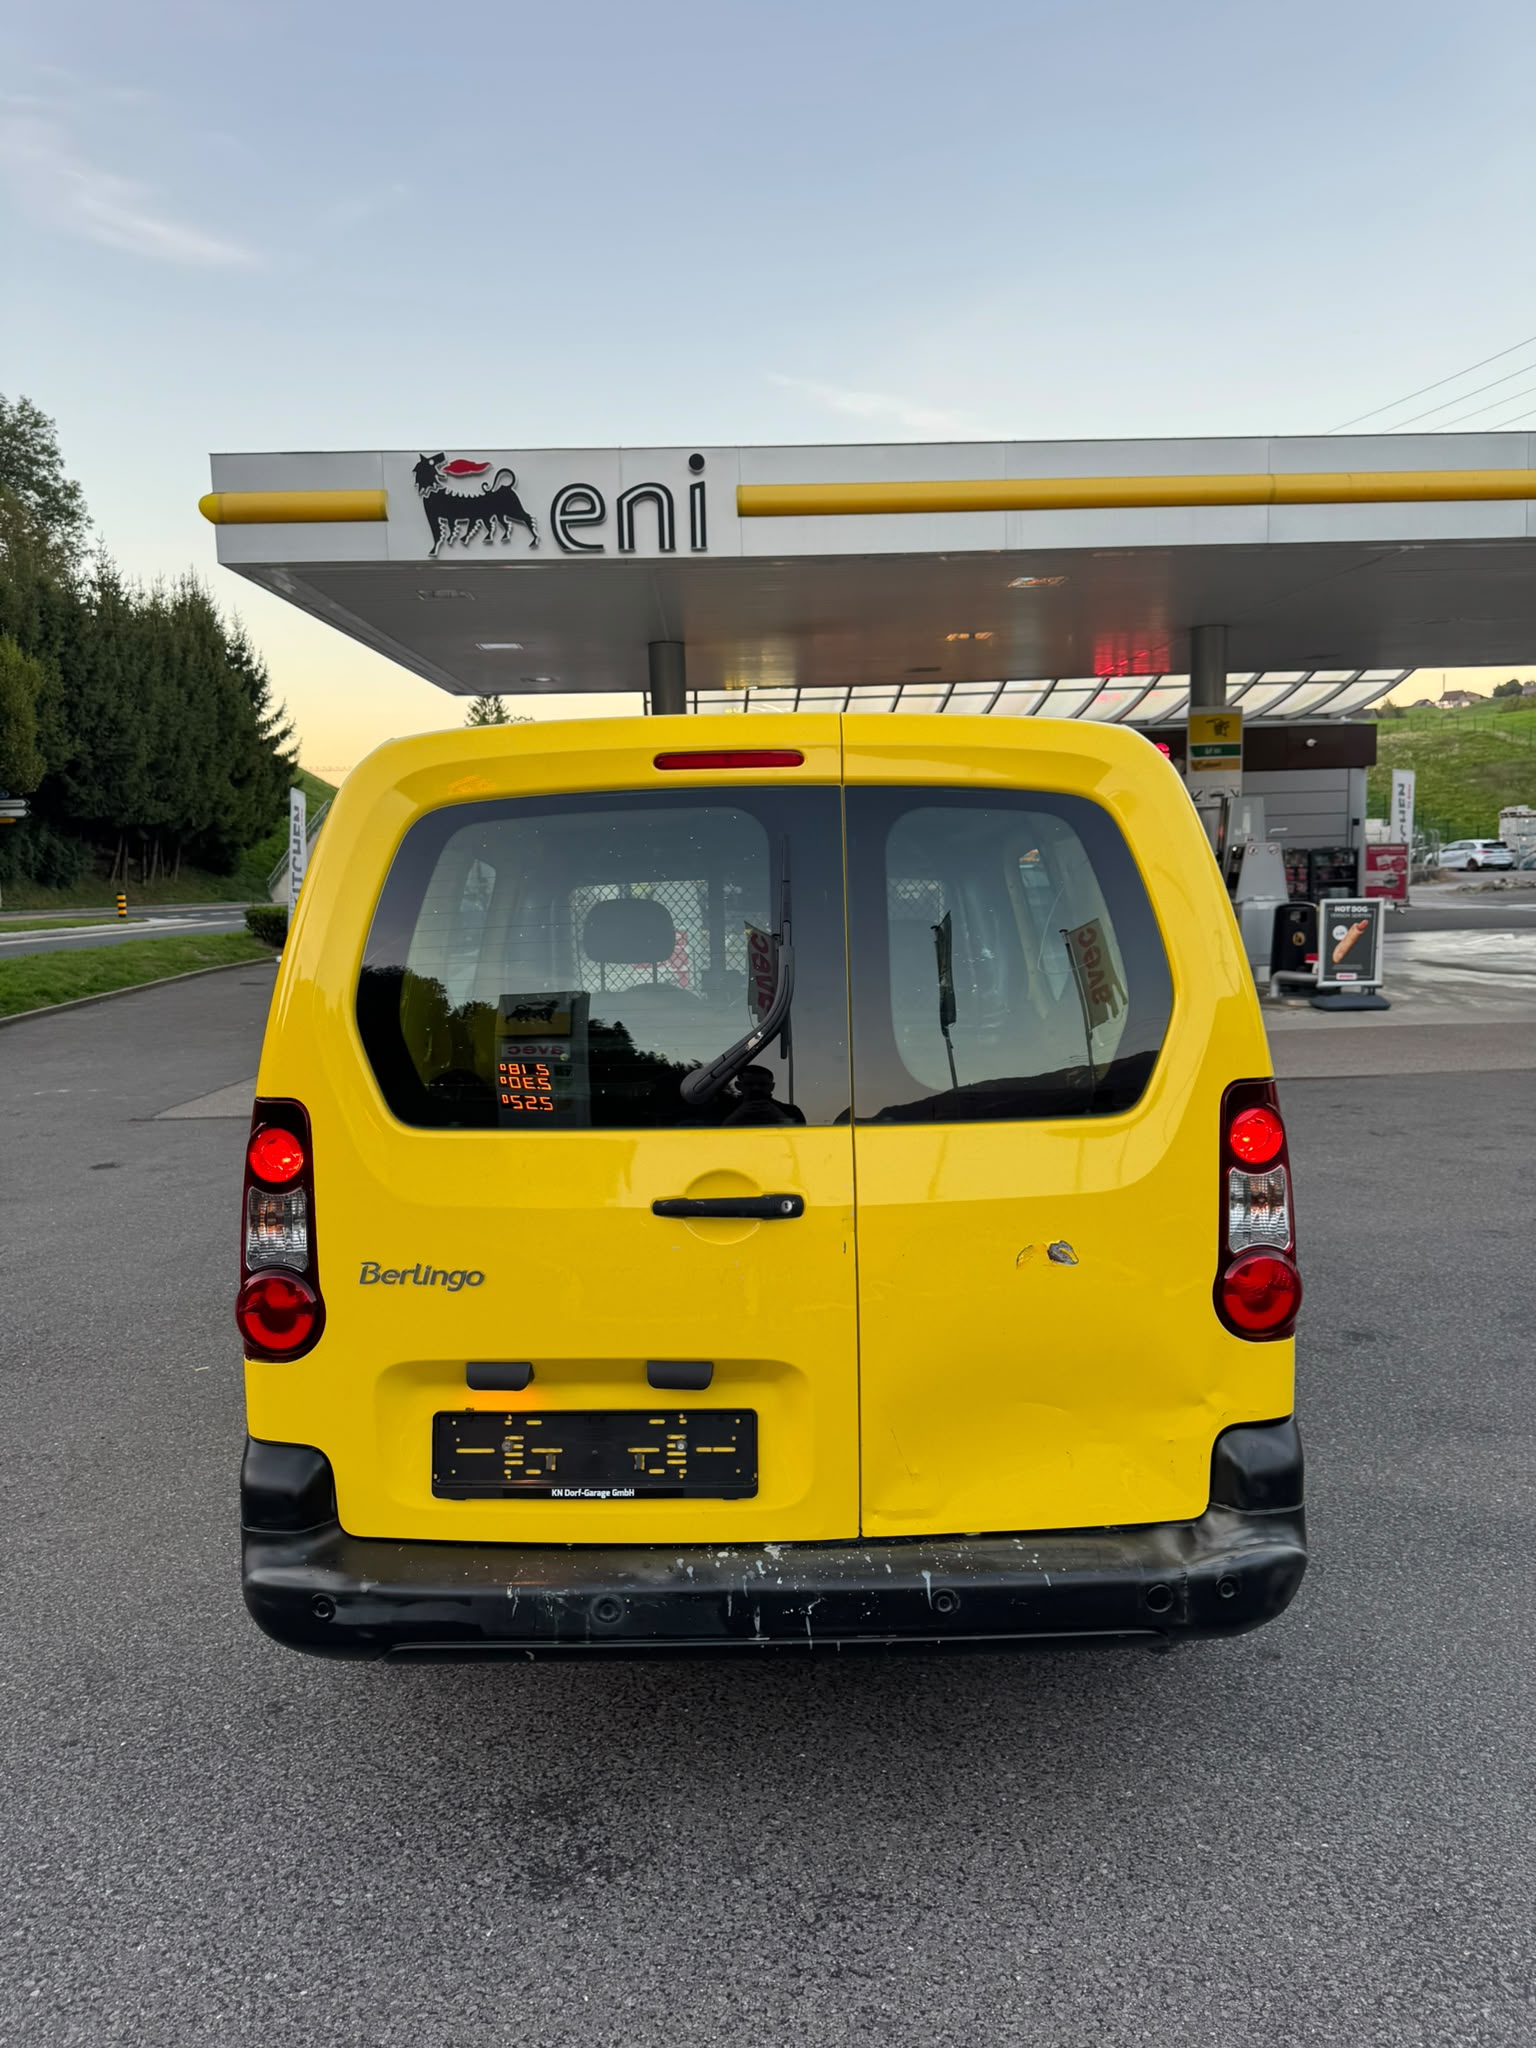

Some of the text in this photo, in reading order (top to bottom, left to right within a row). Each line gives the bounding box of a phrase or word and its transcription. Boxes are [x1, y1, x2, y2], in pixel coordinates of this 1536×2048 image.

[550, 453, 707, 552] eni
[359, 1262, 485, 1292] Berlingo
[551, 1488, 635, 1499] KN Dorf-Garage GmbH
